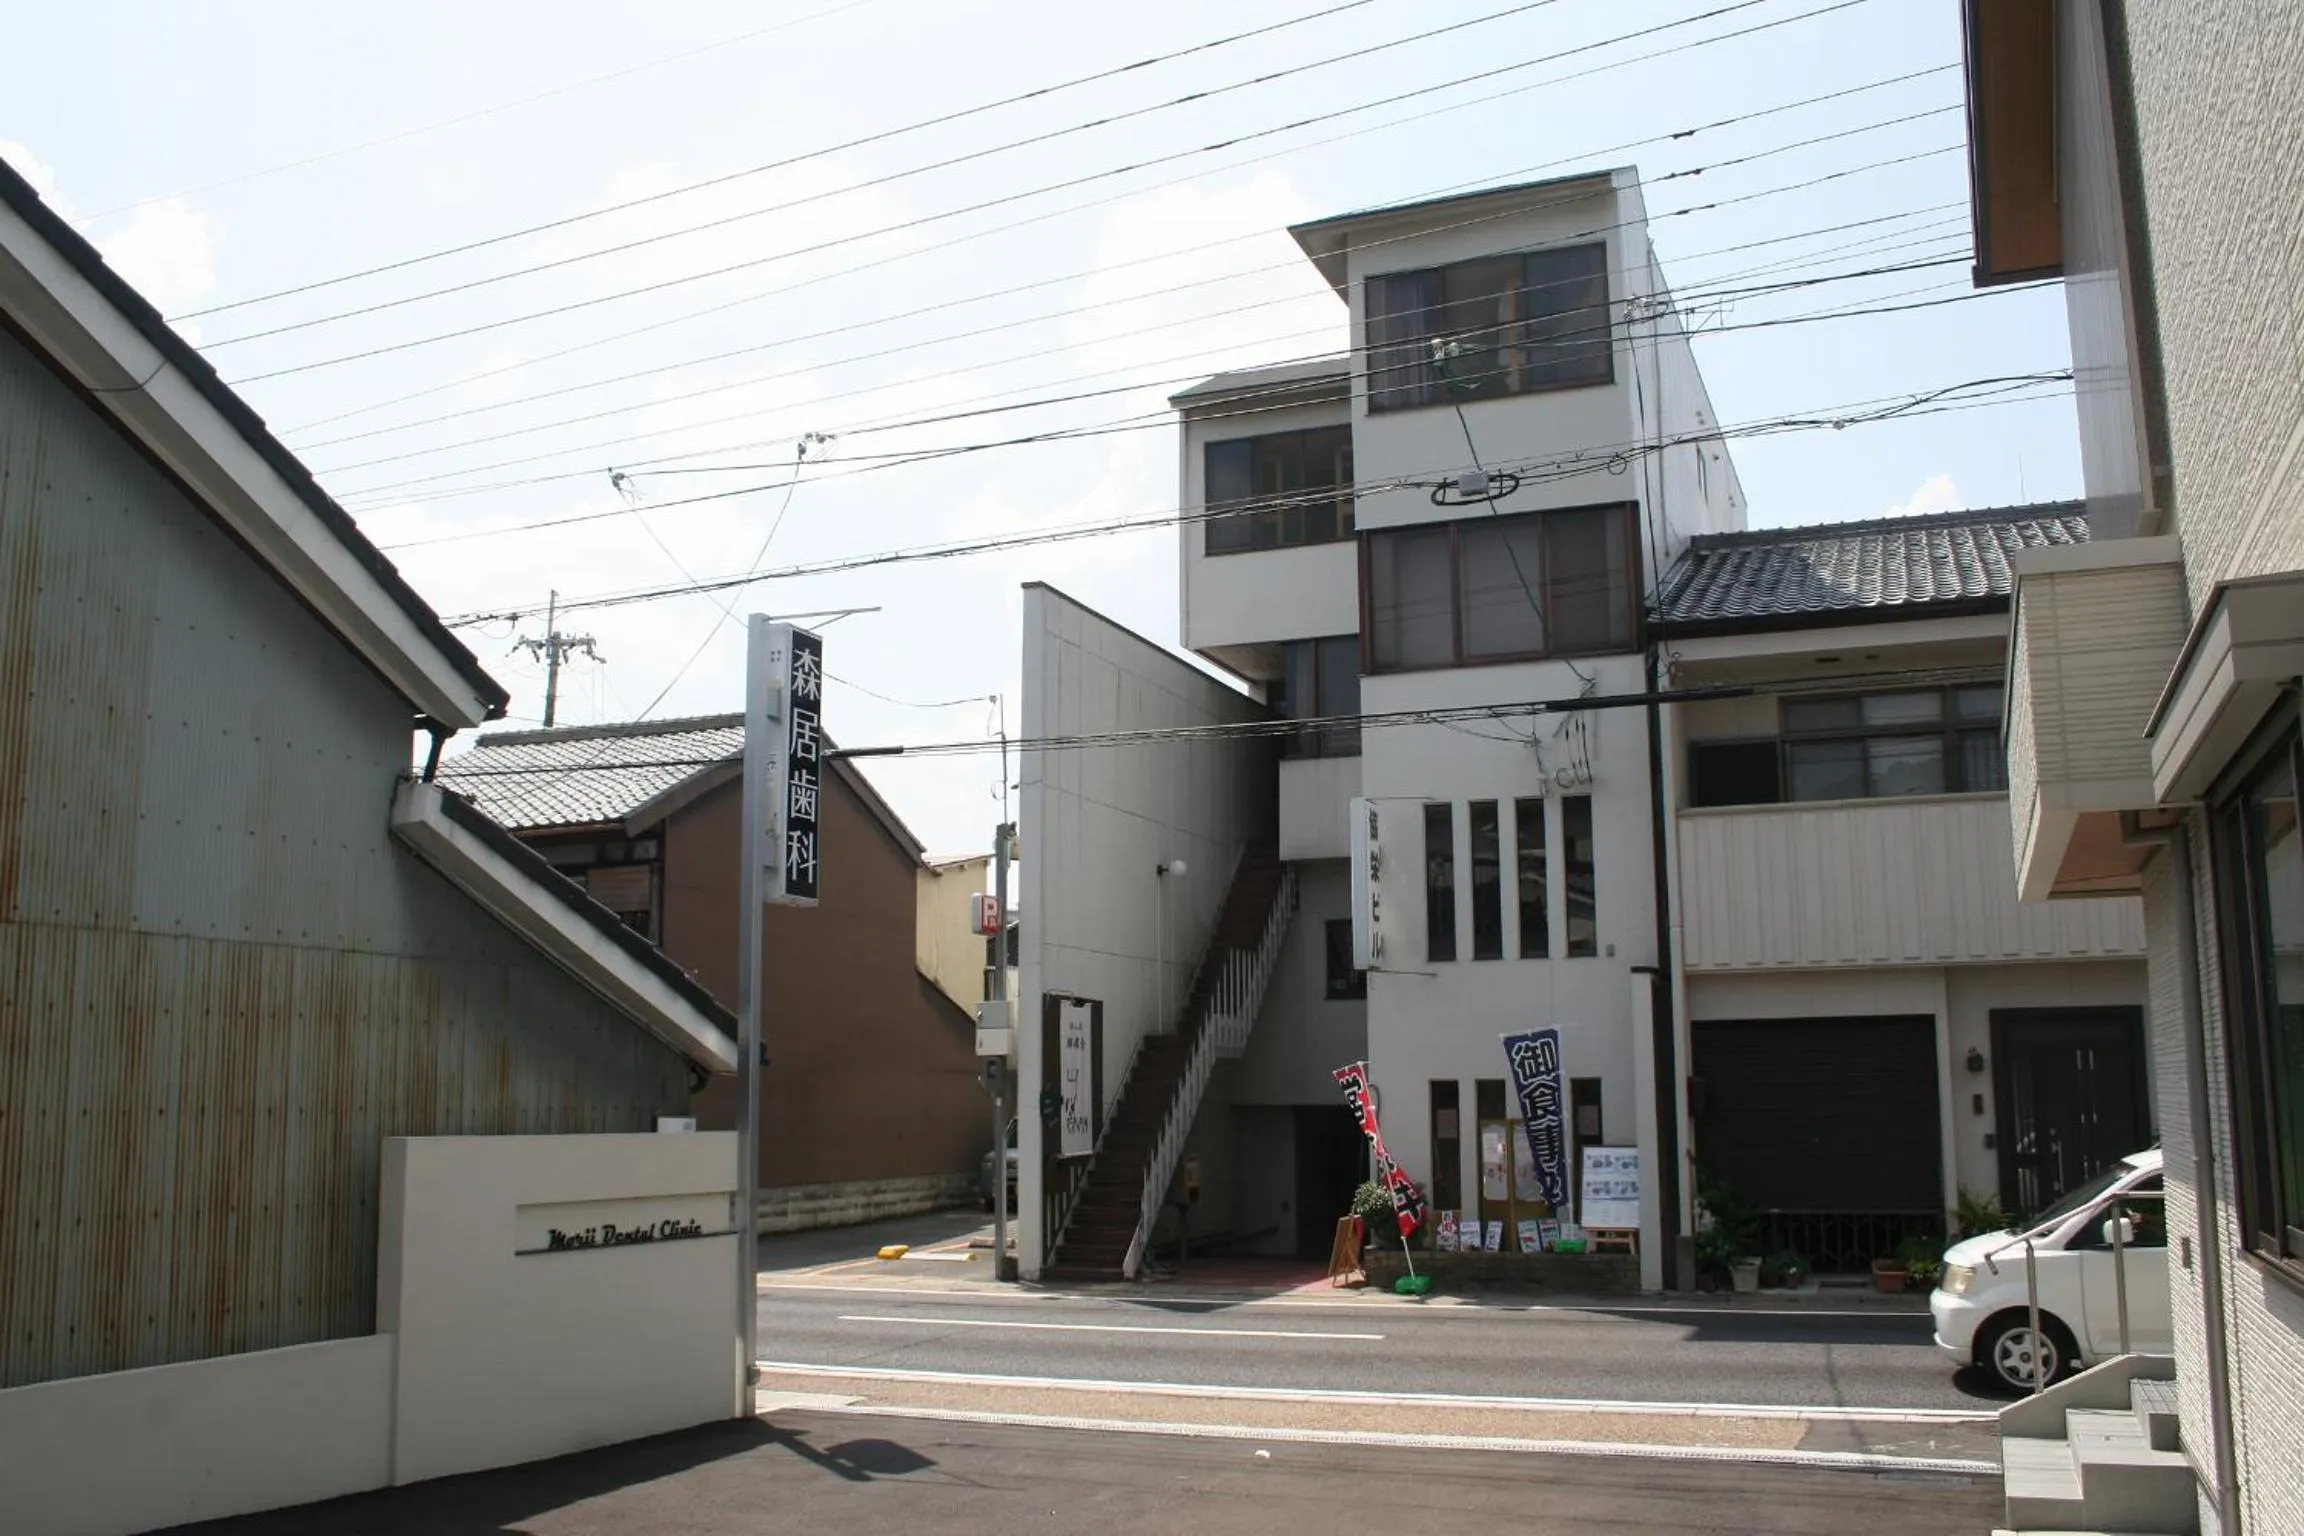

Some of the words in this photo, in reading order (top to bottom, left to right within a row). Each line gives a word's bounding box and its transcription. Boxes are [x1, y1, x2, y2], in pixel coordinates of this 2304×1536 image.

[787, 648, 821, 885] 森居歯科
[602, 1223, 655, 1244] Dental
[660, 1218, 702, 1238] Clinic
